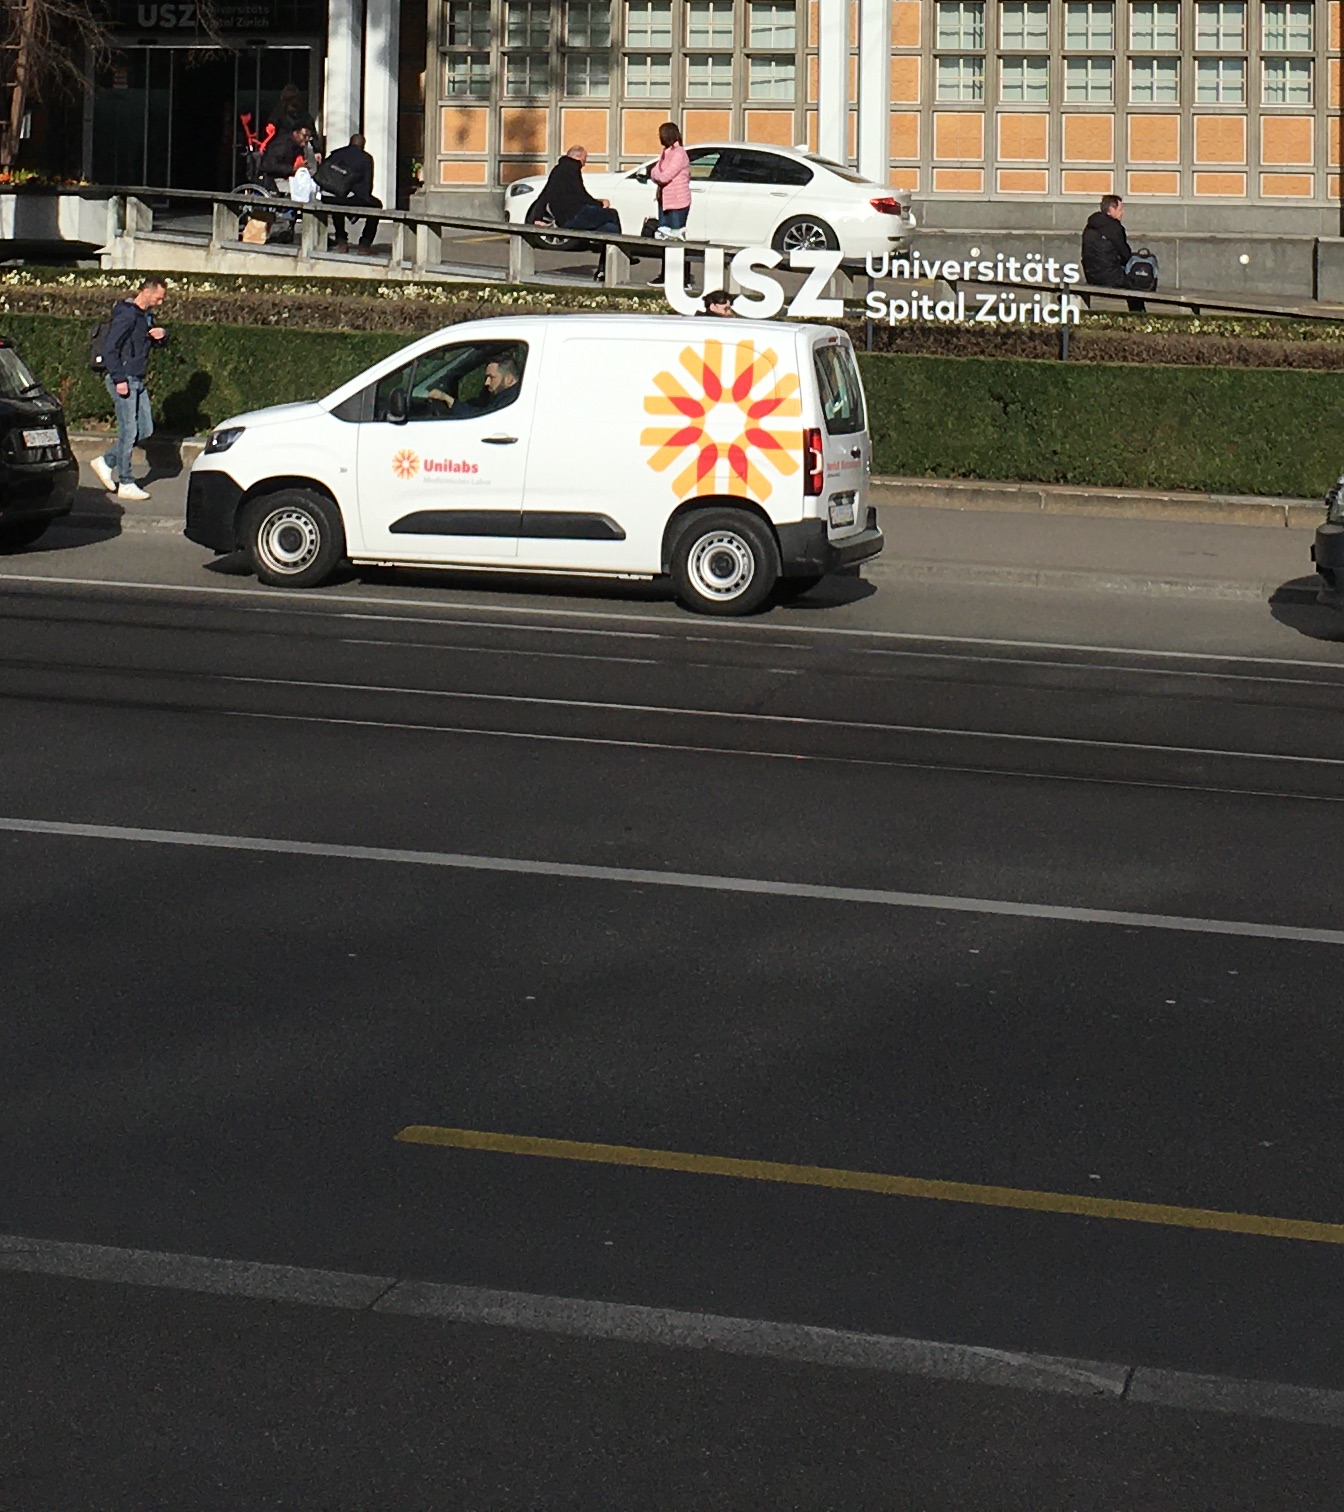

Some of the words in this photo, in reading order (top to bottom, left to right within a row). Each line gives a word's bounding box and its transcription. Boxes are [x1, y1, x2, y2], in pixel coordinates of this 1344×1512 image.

[137, 4, 196, 28] USZ
[664, 247, 845, 319] USZ
[865, 250, 1081, 285] Universitäts
[865, 290, 965, 326] Spital
[975, 292, 1080, 325] Zürich
[423, 458, 479, 474] Unilabs
